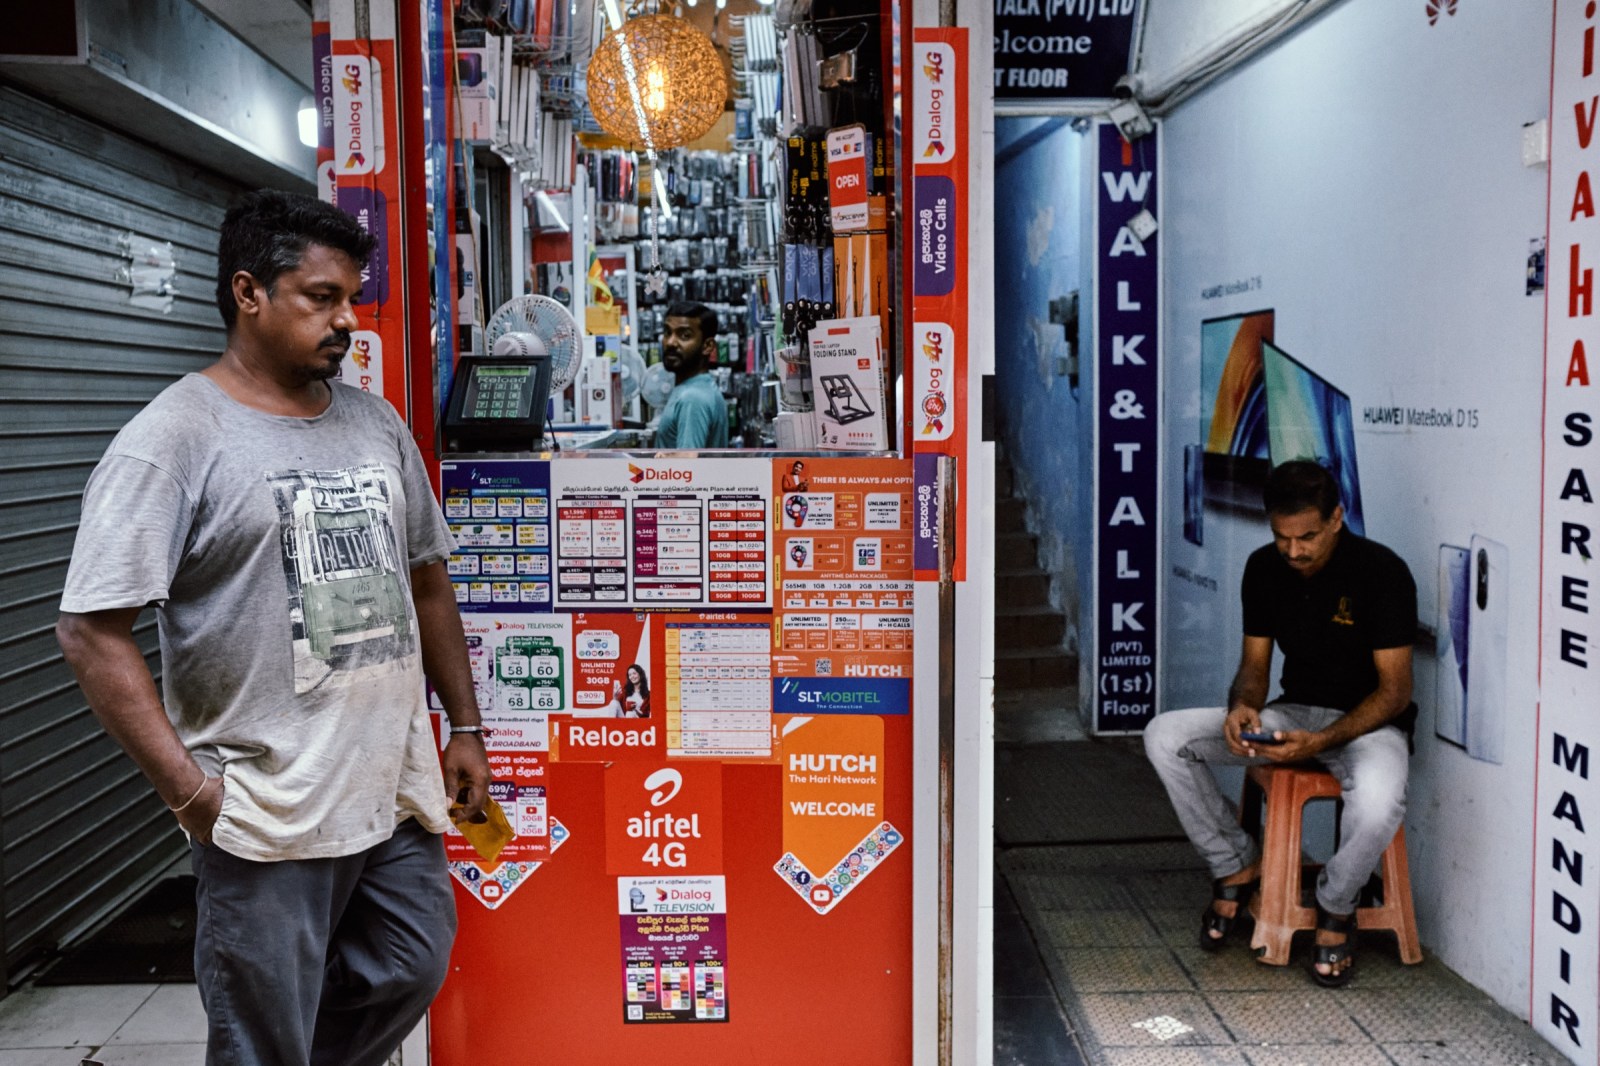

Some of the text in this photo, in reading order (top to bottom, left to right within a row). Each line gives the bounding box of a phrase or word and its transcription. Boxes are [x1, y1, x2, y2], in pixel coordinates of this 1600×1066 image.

[994, 29, 1092, 54] lcome
[1007, 68, 1069, 88] FLOOR
[321, 55, 332, 128] Video Calls
[923, 51, 944, 140] Dialog 4G
[342, 64, 363, 150] Dialog 4G
[831, 148, 842, 156] VISA
[835, 173, 860, 189] OPEN
[357, 208, 369, 234] alls
[935, 198, 947, 274] Video Calls
[813, 348, 857, 358] FOLDING STAND
[923, 331, 943, 363] 4G
[477, 376, 527, 384] Reload
[1363, 407, 1479, 428] HUAWEI MateBook D 15
[645, 468, 693, 483] Dialog
[317, 527, 378, 571] RETRO
[1559, 413, 1594, 669] SAREE
[502, 622, 525, 630] Dialog
[1111, 641, 1143, 654] (PVT)
[1102, 655, 1152, 667] LIMITED
[508, 666, 523, 675] 58
[537, 666, 553, 675] 60
[586, 677, 610, 685] 30GB
[1100, 672, 1153, 695] (1st)
[508, 698, 523, 707] 68
[538, 698, 554, 707] 68
[797, 691, 881, 703] SLTMOBITEL
[1103, 700, 1150, 715] Floor
[492, 728, 523, 737] Dialog
[569, 726, 656, 747] Reload
[789, 754, 877, 773] HUTCH
[789, 774, 877, 785] The Hari Network
[790, 801, 876, 817] WELCOME
[626, 811, 701, 838] airtel
[642, 842, 687, 867] 4G
[671, 889, 711, 901] Dialog
[1550, 732, 1590, 1048] MANDIR
[653, 903, 715, 912] TELEVISION
